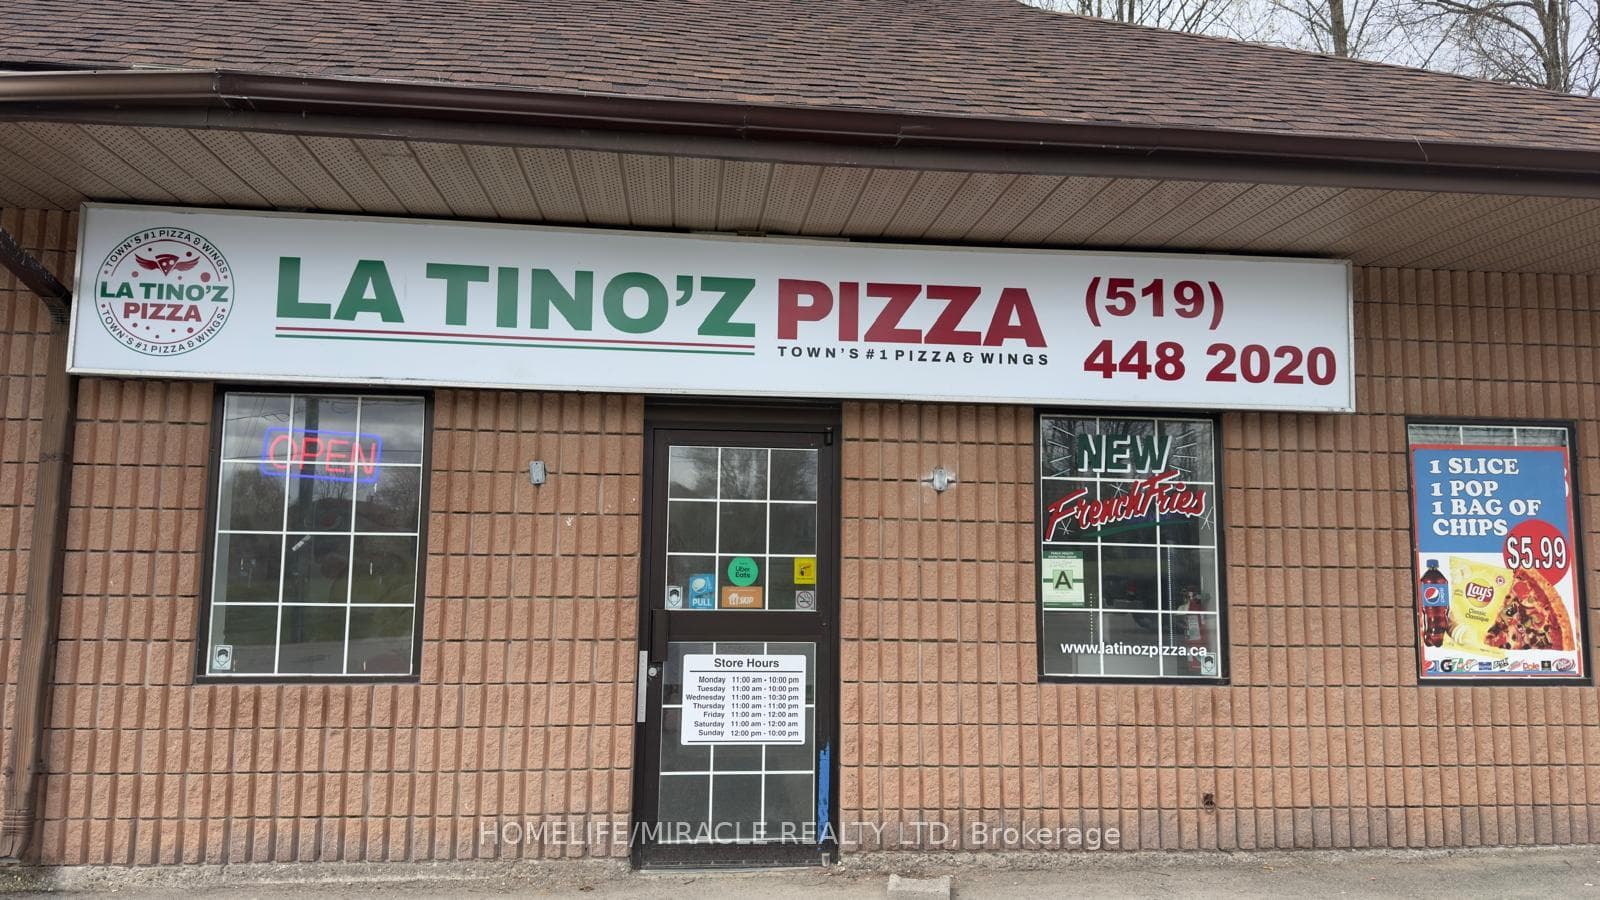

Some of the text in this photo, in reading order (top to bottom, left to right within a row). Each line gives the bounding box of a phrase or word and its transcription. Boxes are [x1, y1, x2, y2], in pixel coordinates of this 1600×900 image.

[105, 236, 142, 267] TOWN'S
[160, 230, 191, 242] PIZZA
[193, 237, 200, 245] &
[202, 242, 228, 274] WINGS
[100, 281, 229, 303] LA TINO'Z
[276, 256, 1048, 348] LA TINO'Z PIZZA
[123, 302, 202, 322] PIZZA
[1084, 276, 1224, 330] (519)
[102, 309, 134, 345] TOWN'S
[150, 344, 186, 354] PIZZA
[187, 340, 194, 348] &
[195, 313, 225, 343] WINGS
[778, 346, 859, 359] TOWN'S
[895, 349, 956, 363] PIZZA
[962, 351, 974, 364] &
[980, 352, 1048, 366] WINGS
[1083, 339, 1337, 386] 448 2020
[268, 434, 377, 475] OPEN
[1076, 433, 1172, 474] NEW
[1430, 458, 1520, 474] 1 SLICE
[1431, 480, 1499, 497] 1 POP
[1432, 498, 1542, 516] 1 BAG OF
[1432, 518, 1508, 536] CHIPS
[1506, 536, 1567, 570] $5.99
[1055, 570, 1072, 589] A
[692, 598, 712, 606] PULL
[1060, 642, 1208, 658] www.latinozpizza.ca
[714, 658, 780, 668] Store Hours
[1522, 662, 1540, 670] Dole
[698, 676, 726, 684] Monday
